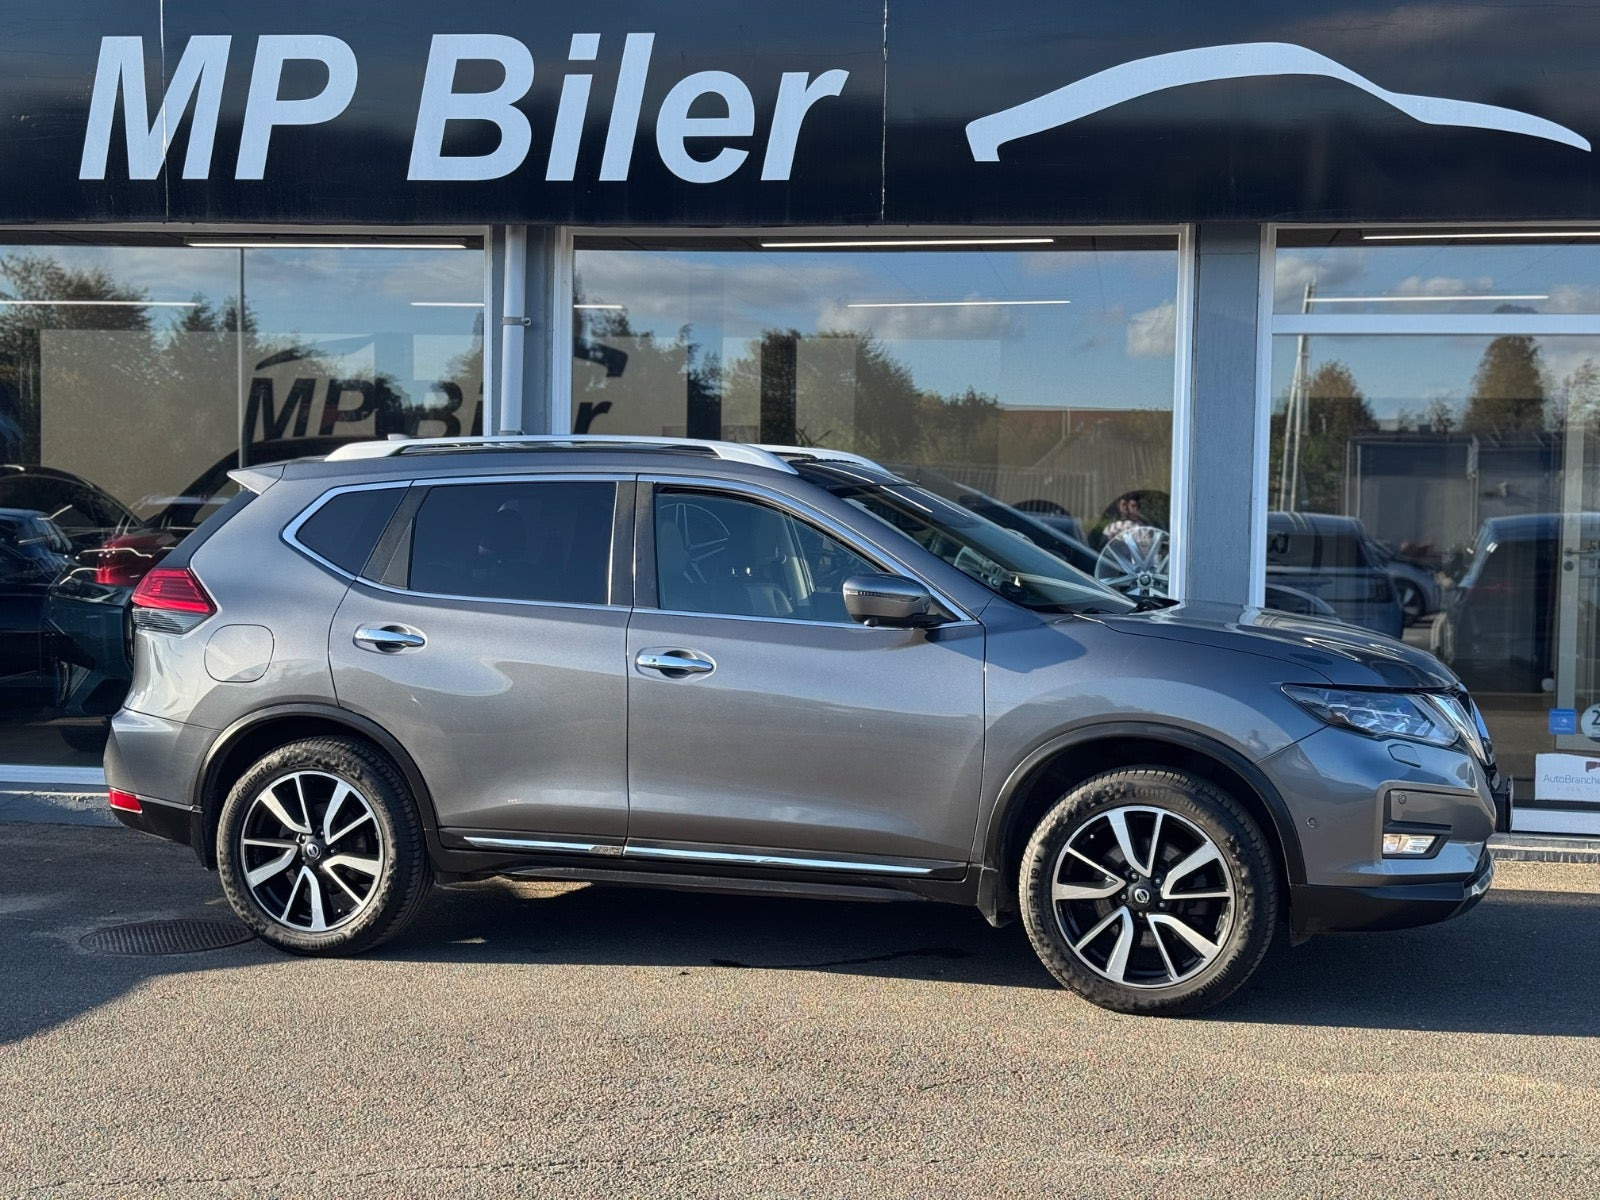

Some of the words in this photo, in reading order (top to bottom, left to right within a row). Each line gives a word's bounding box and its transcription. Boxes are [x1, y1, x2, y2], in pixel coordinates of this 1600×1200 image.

[78, 34, 359, 181] MP
[407, 32, 850, 184] Biler
[247, 377, 377, 442] MP
